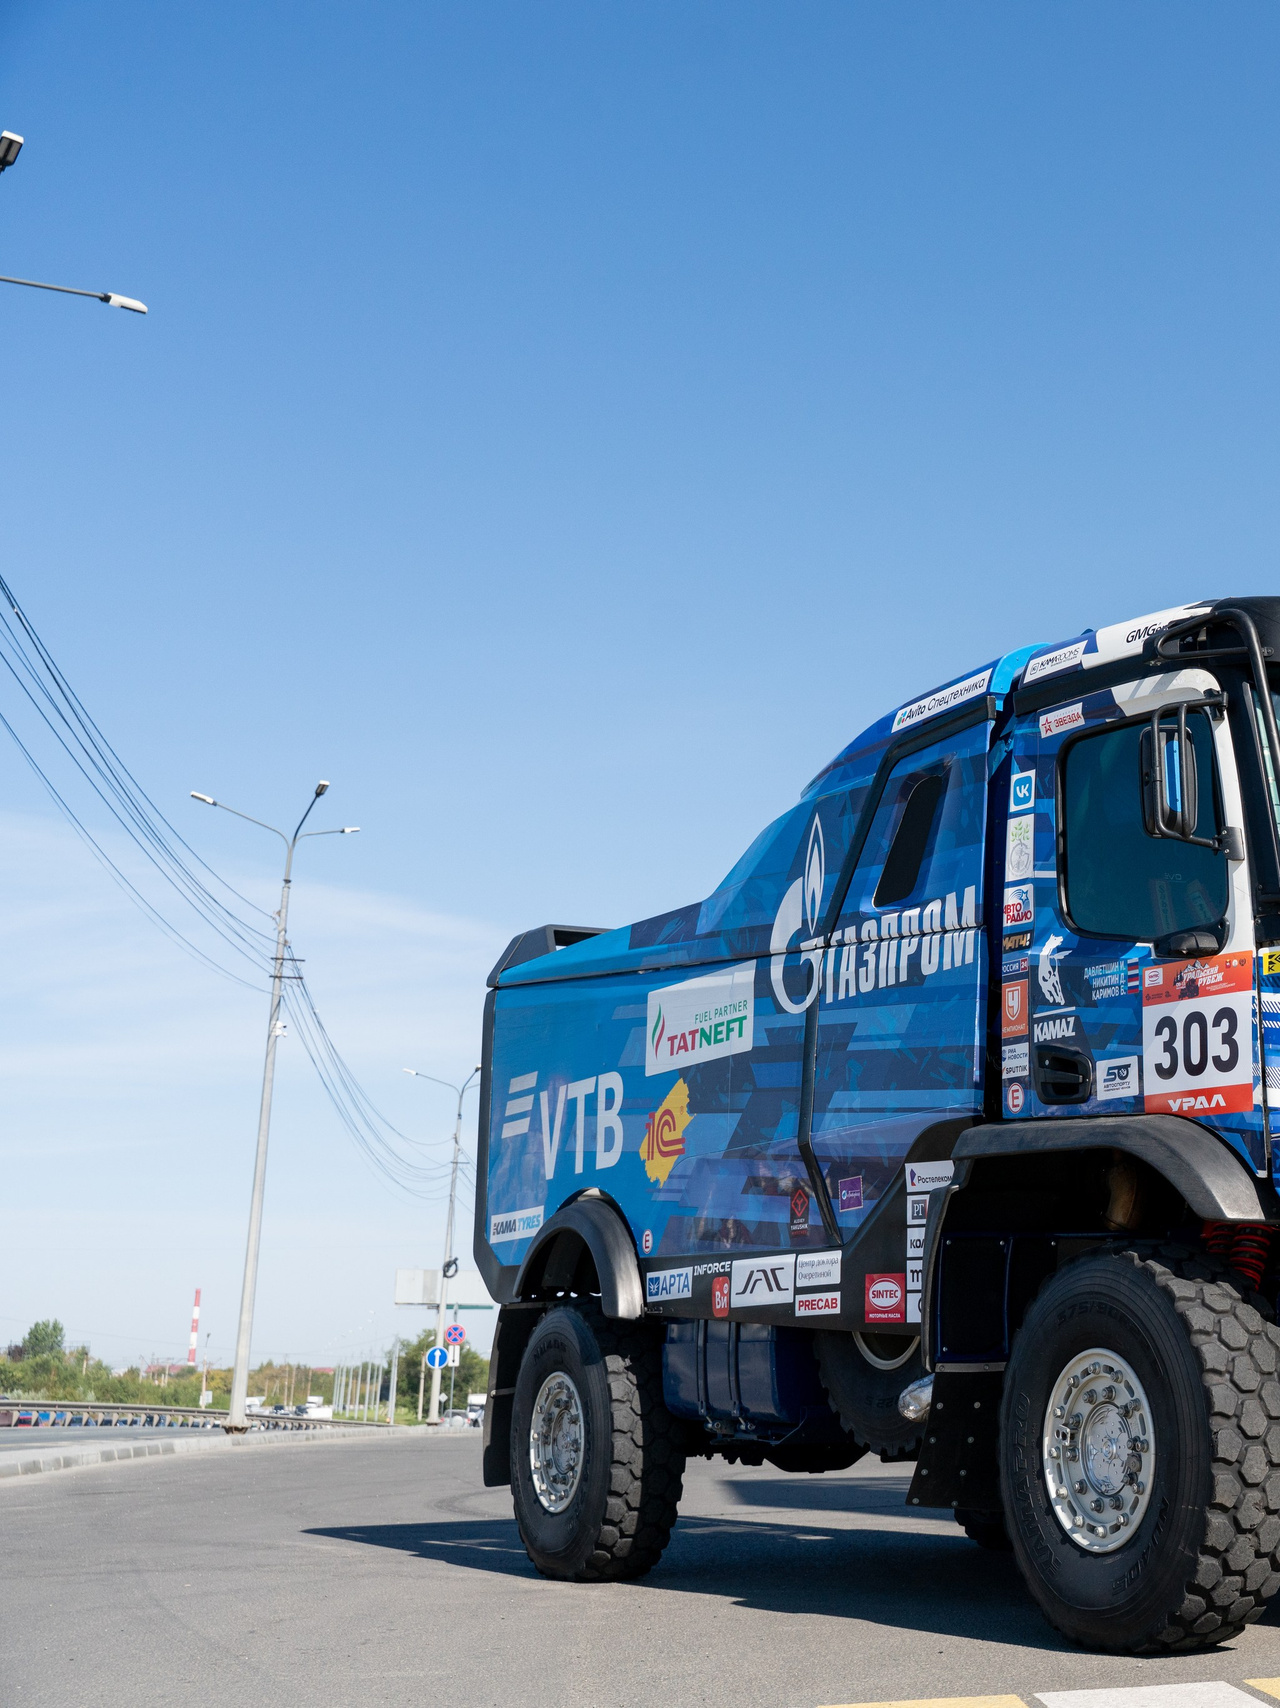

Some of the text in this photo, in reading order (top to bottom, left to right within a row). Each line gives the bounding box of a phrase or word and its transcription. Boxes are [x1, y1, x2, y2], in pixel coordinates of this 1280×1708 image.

[906, 677, 986, 721] Avito Спецтехника
[1054, 712, 1082, 728] ЗВЕЗДА
[1016, 783, 1030, 799] VK
[1006, 910, 1033, 924] РАДИО
[825, 885, 976, 1004] ГАЗПРОМ
[1002, 962, 1019, 973] ОССИЯ
[1084, 961, 1126, 980] ДАВЛЕТШИН И.
[1183, 965, 1219, 981] УРАЛЬСКИЙ
[1092, 974, 1119, 988] НИКИТИН
[1198, 972, 1224, 987] РУБЕЖ
[1092, 986, 1119, 1000] КАРИМОВ
[694, 1000, 748, 1024] FUEL PARTNER
[667, 1015, 748, 1057] TATNEFT
[1033, 1016, 1076, 1043] KAMAZ
[1154, 1006, 1240, 1080] 303
[1008, 1052, 1028, 1061] НОВОСТИ
[1005, 1065, 1028, 1075] SPUTNIK
[1168, 1093, 1227, 1112] УРАЛ
[539, 1071, 624, 1181] VTB
[917, 1174, 953, 1185] Ростелеком
[913, 1203, 925, 1217] РГ
[492, 1214, 542, 1236] KAMA TYRES
[694, 1261, 731, 1276] INFORCE
[660, 1272, 690, 1296] АРТА
[735, 1267, 790, 1295] JAC
[871, 1289, 899, 1299] SINTEC
[798, 1297, 838, 1311] PRECAB
